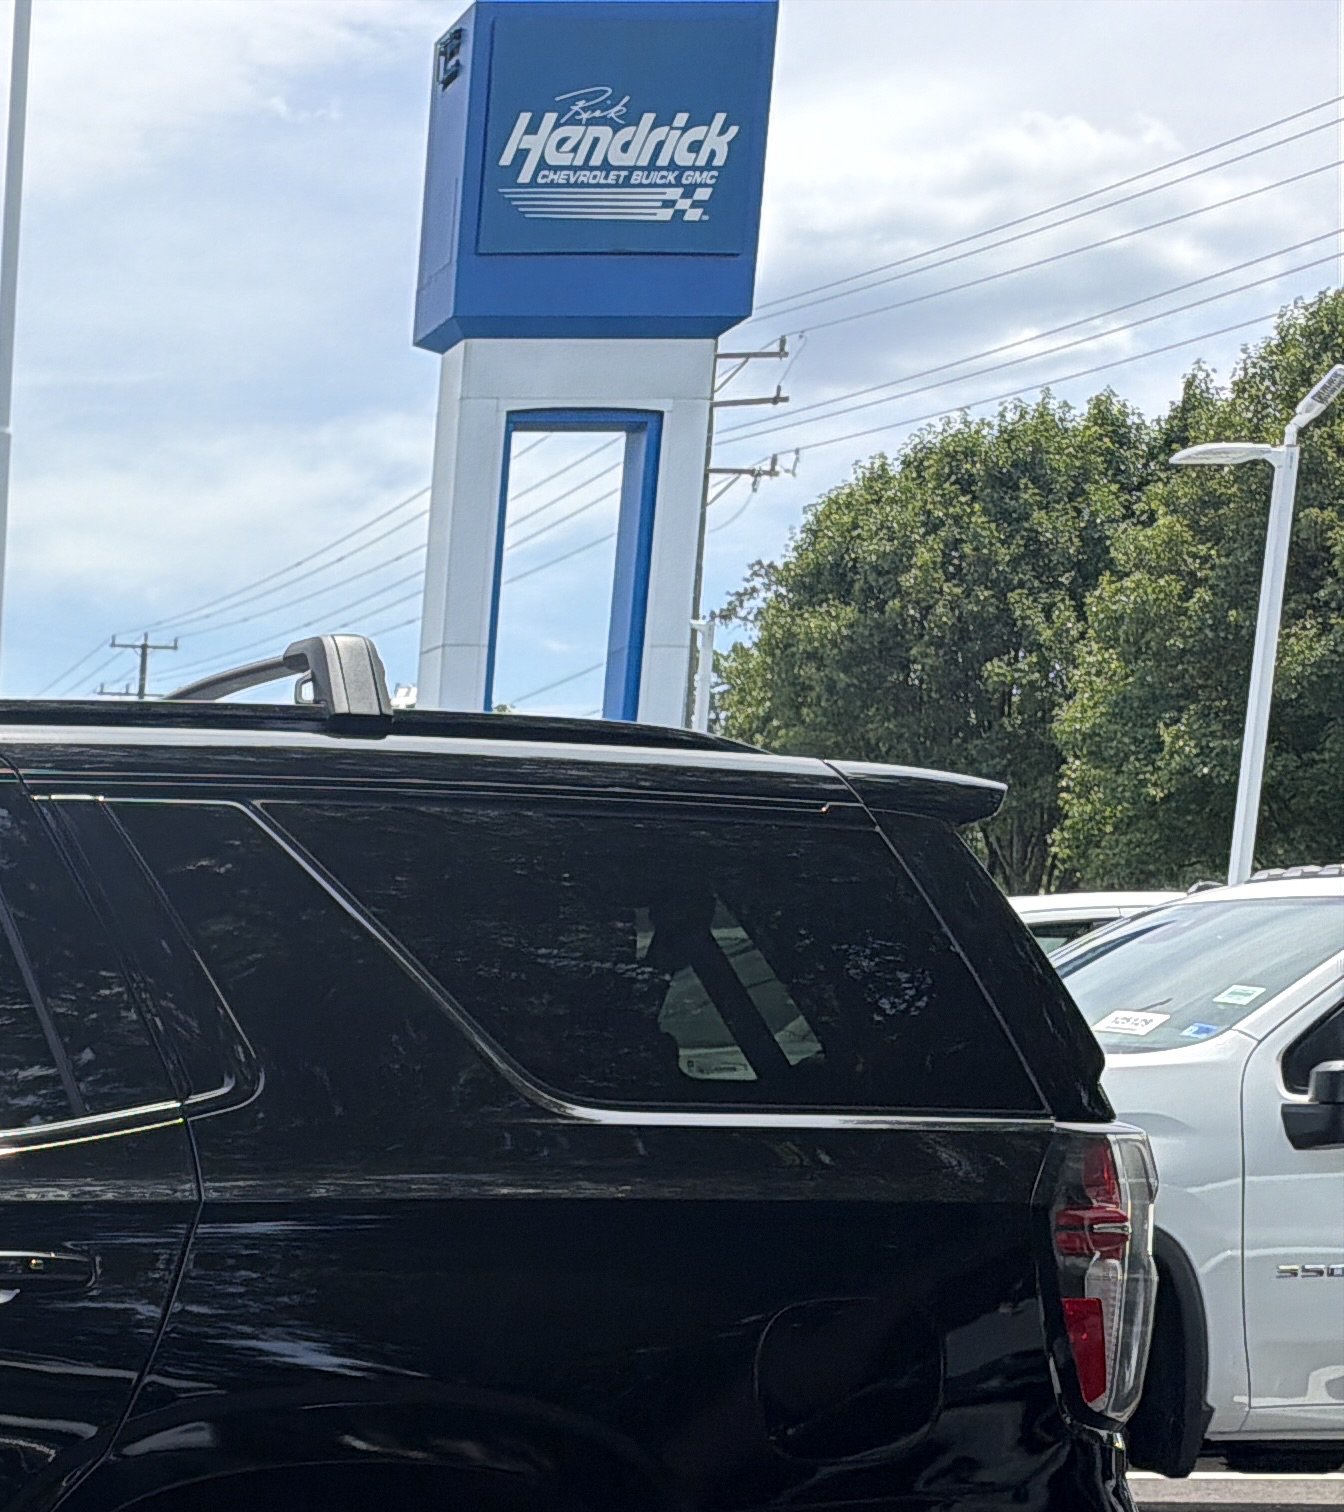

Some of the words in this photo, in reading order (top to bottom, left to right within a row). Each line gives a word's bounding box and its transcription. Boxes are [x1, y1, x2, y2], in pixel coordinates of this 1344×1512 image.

[554, 86, 630, 125] Rick
[499, 112, 740, 184] Hendrick
[536, 170, 629, 185] CHEVROLET
[630, 170, 677, 185] BUICK
[681, 170, 719, 185] GMC
